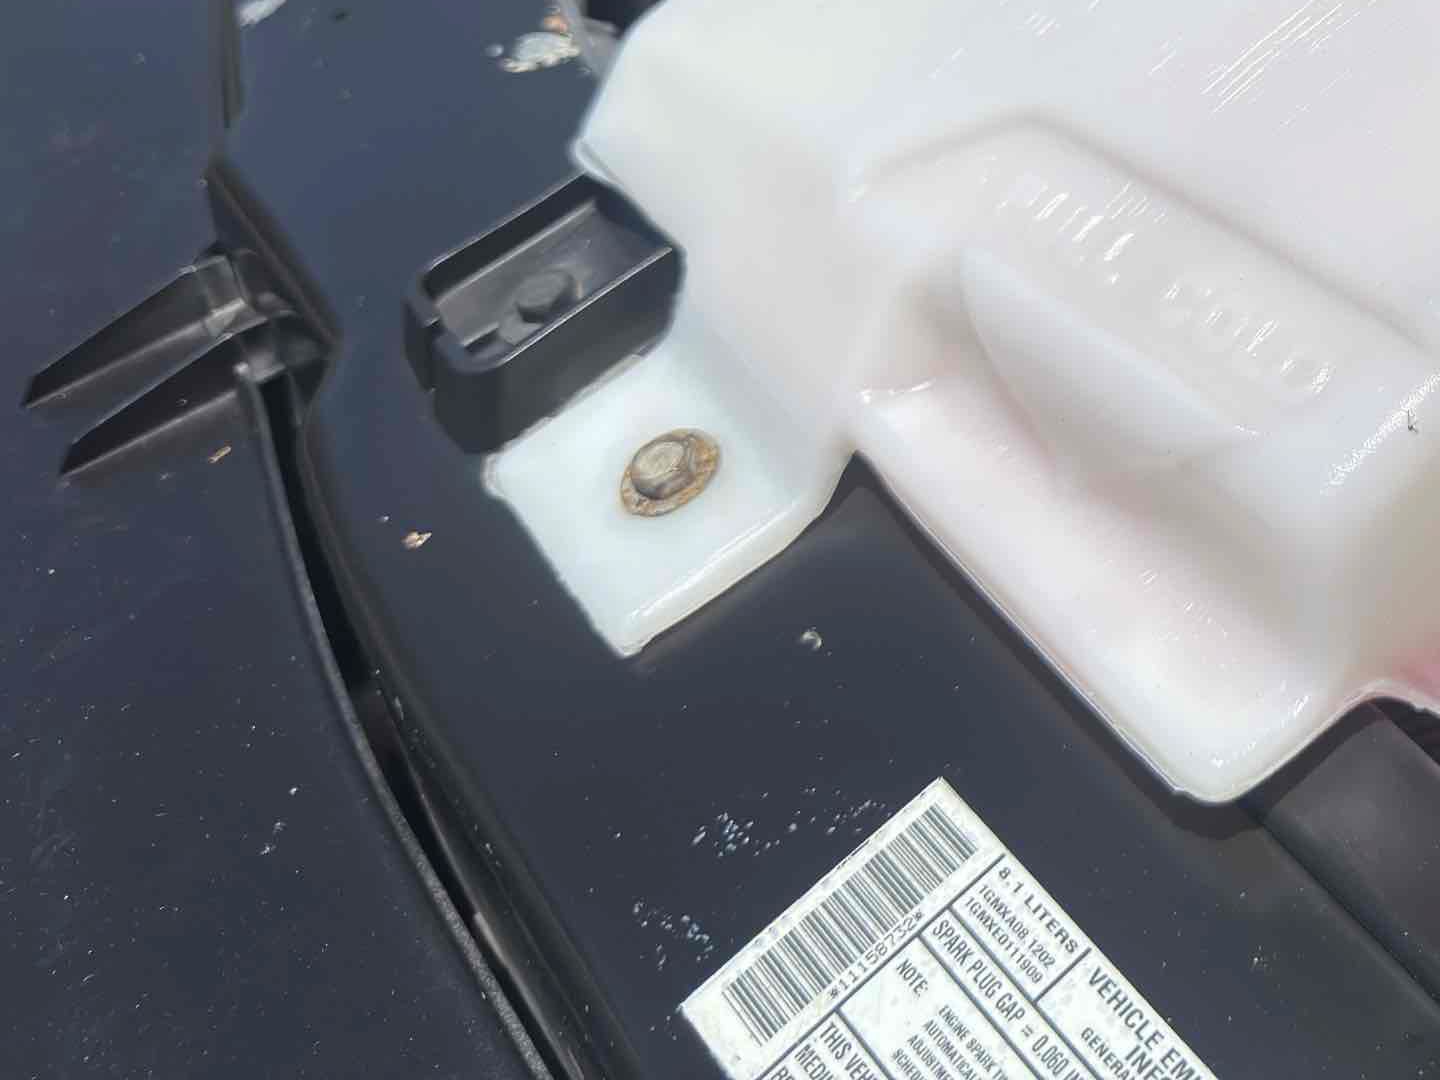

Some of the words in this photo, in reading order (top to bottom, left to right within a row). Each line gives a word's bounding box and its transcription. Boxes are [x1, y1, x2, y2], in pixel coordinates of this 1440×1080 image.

[998, 866, 1025, 894] 8.1
[1024, 893, 1079, 954] LITERS
[896, 958, 928, 999] NOTE:
[932, 919, 975, 967] SPARK
[967, 959, 1003, 1000] PLUG
[995, 991, 1026, 1022] GAP
[1031, 1034, 1070, 1077] 0.060
[820, 1021, 852, 1060] THIS
[938, 1004, 971, 1041] ENGINE
[965, 1038, 997, 1073] SPARK
[1081, 1026, 1138, 1080] GENERA
[1087, 966, 1165, 1051] VEHICLE
[1160, 1047, 1208, 1080] EM
